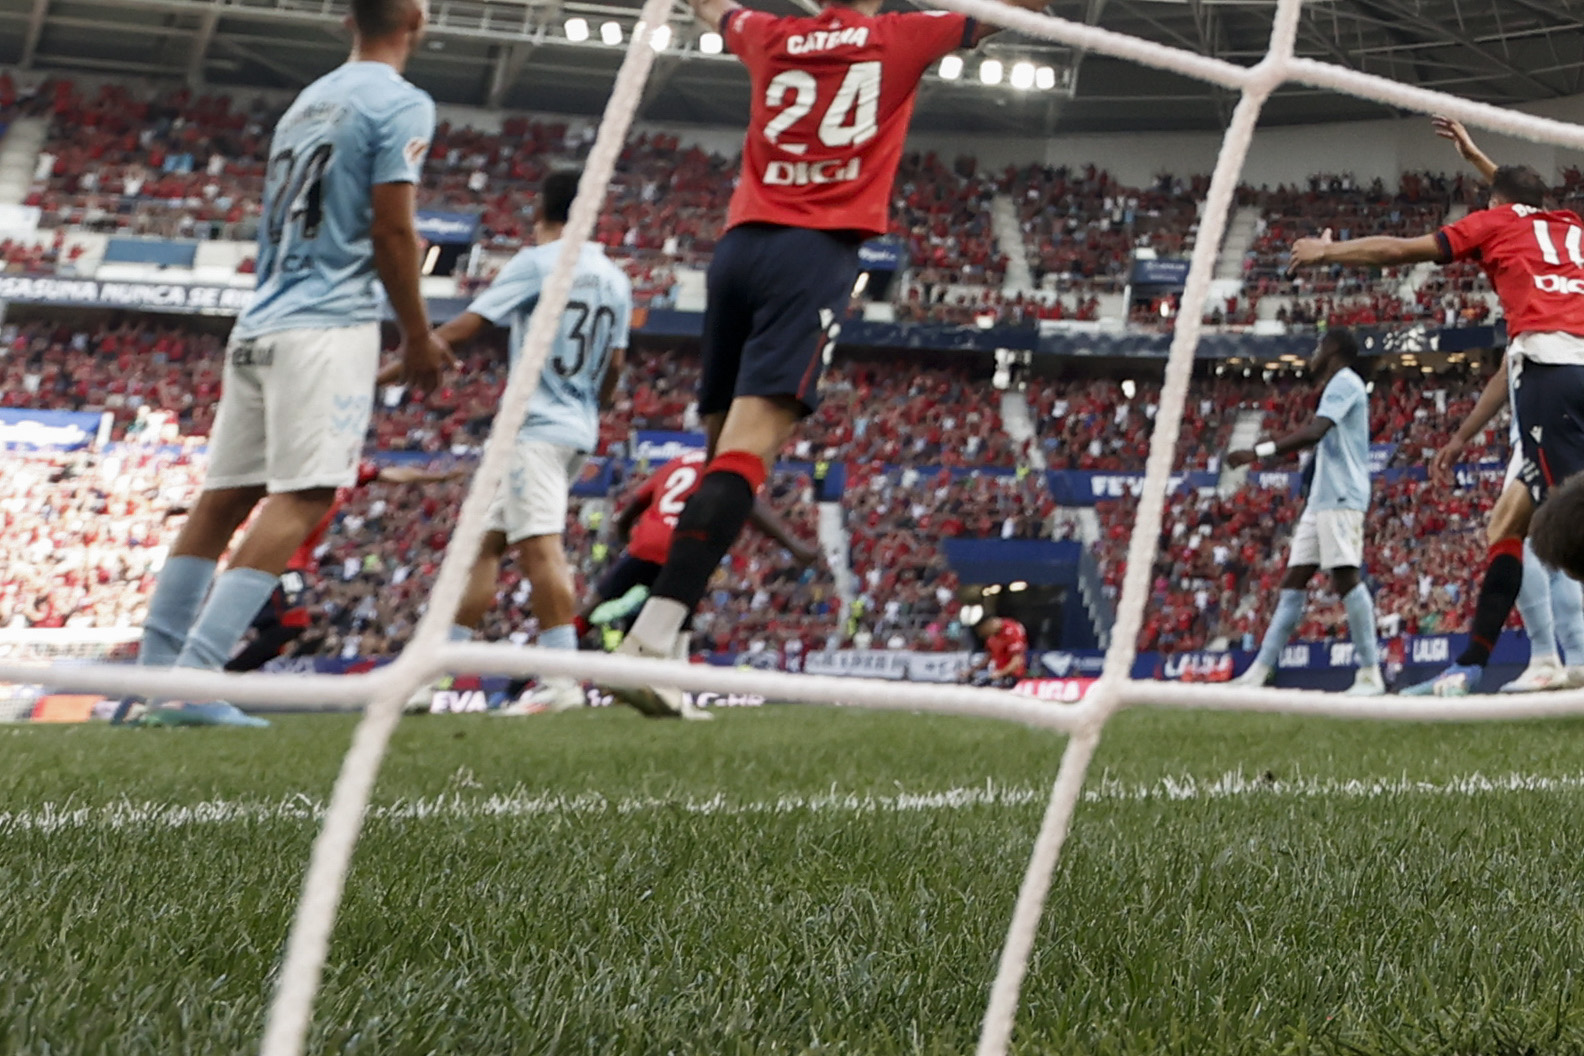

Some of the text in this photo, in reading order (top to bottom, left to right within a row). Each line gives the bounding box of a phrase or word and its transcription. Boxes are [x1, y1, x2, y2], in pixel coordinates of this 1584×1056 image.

[763, 61, 882, 155] 24
[762, 157, 861, 185] DIGI
[551, 300, 616, 382] 30
